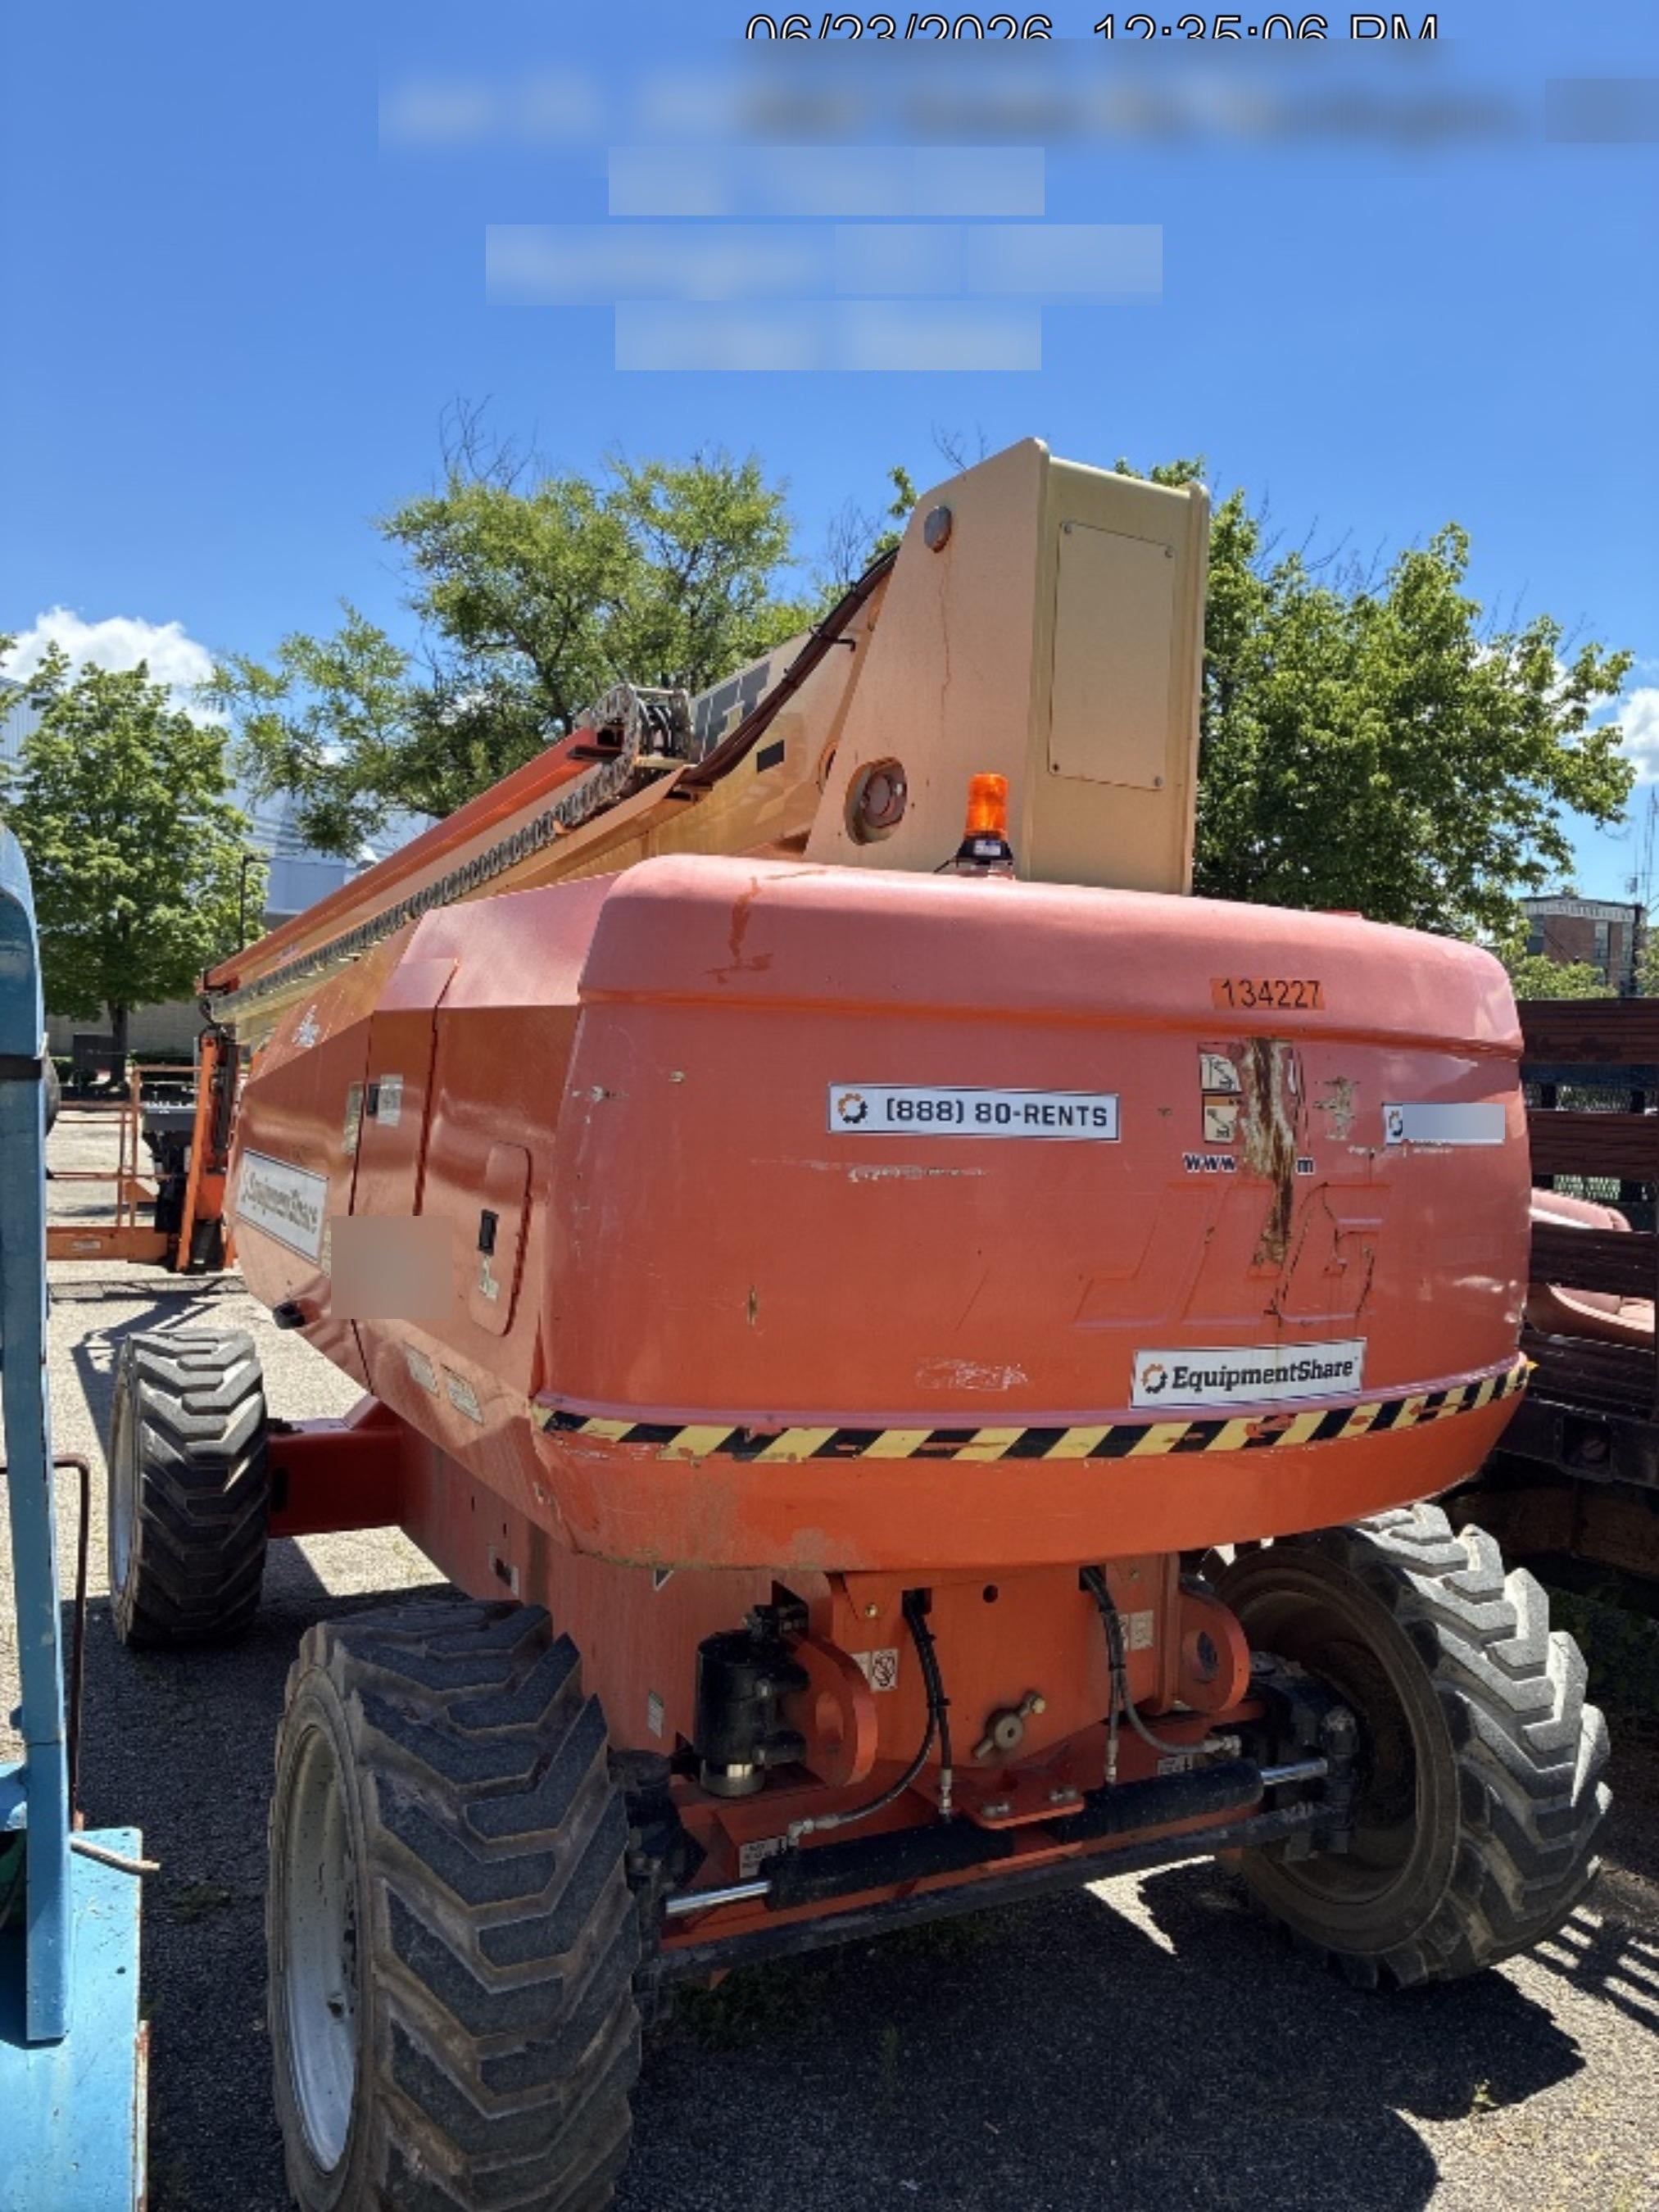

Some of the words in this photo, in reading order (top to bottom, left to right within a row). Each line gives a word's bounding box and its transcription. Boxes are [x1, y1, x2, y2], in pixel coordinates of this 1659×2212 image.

[1222, 978, 1320, 1008] 134227
[886, 1098, 964, 1123] (888)
[975, 1103, 1107, 1126] 80-RENTS
[1172, 1358, 1353, 1393] EquipmentShare
